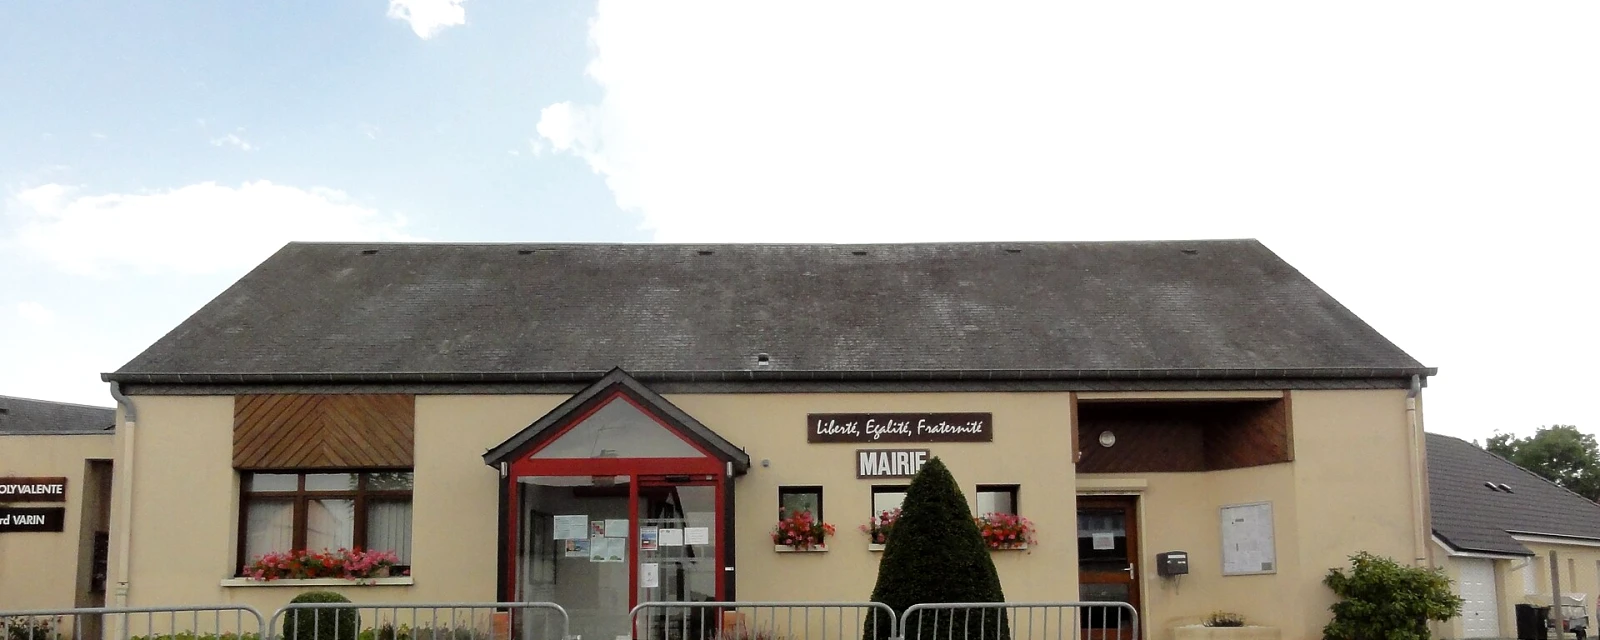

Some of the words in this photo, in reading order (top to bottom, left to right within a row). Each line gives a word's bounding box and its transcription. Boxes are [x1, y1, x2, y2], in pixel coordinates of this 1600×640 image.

[816, 419, 860, 436] Liberté,
[866, 419, 912, 439] Egalité,
[917, 419, 983, 435] Fraternité
[13, 515, 45, 525] VARIN
